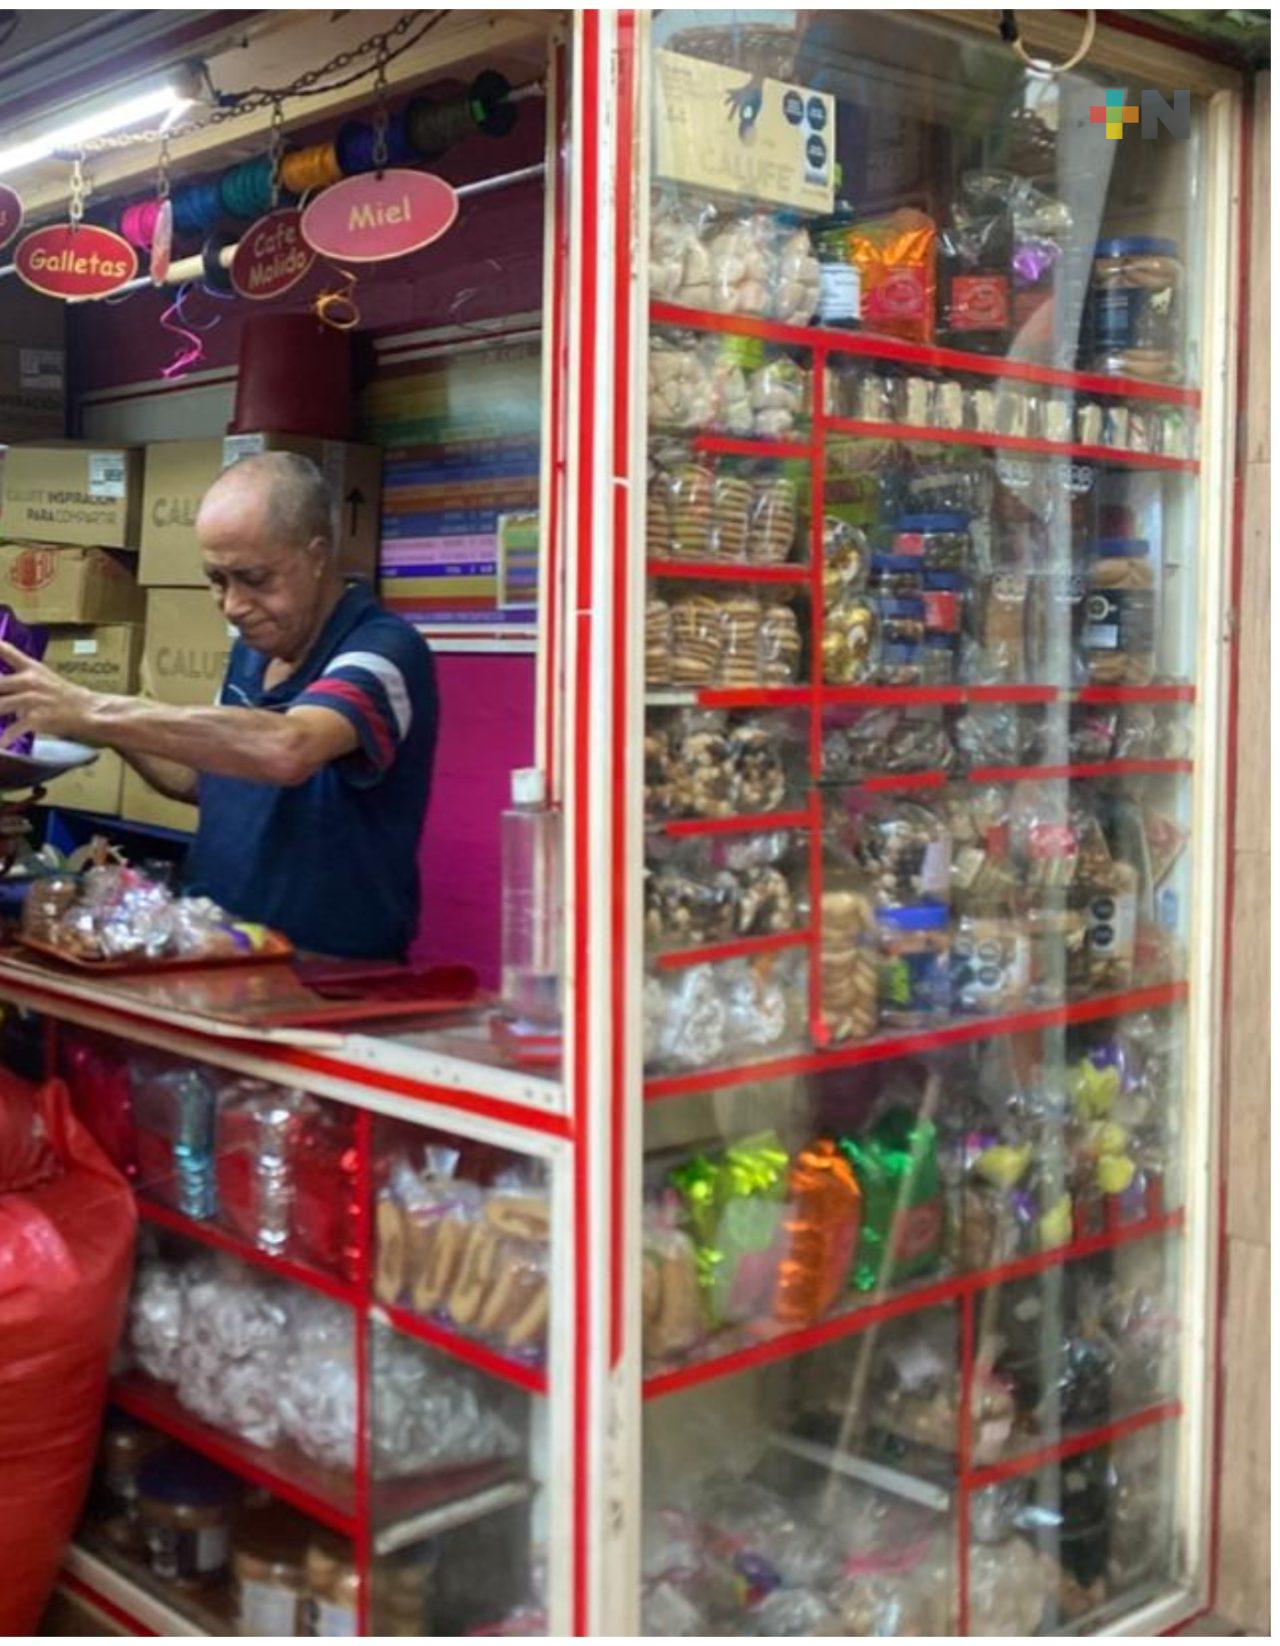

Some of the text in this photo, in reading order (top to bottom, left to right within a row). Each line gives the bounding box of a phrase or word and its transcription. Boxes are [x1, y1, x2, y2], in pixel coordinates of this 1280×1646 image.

[348, 195, 412, 232] Miel
[254, 222, 298, 257] Cafe
[29, 248, 127, 278] Galletas
[247, 248, 307, 290] Molido
